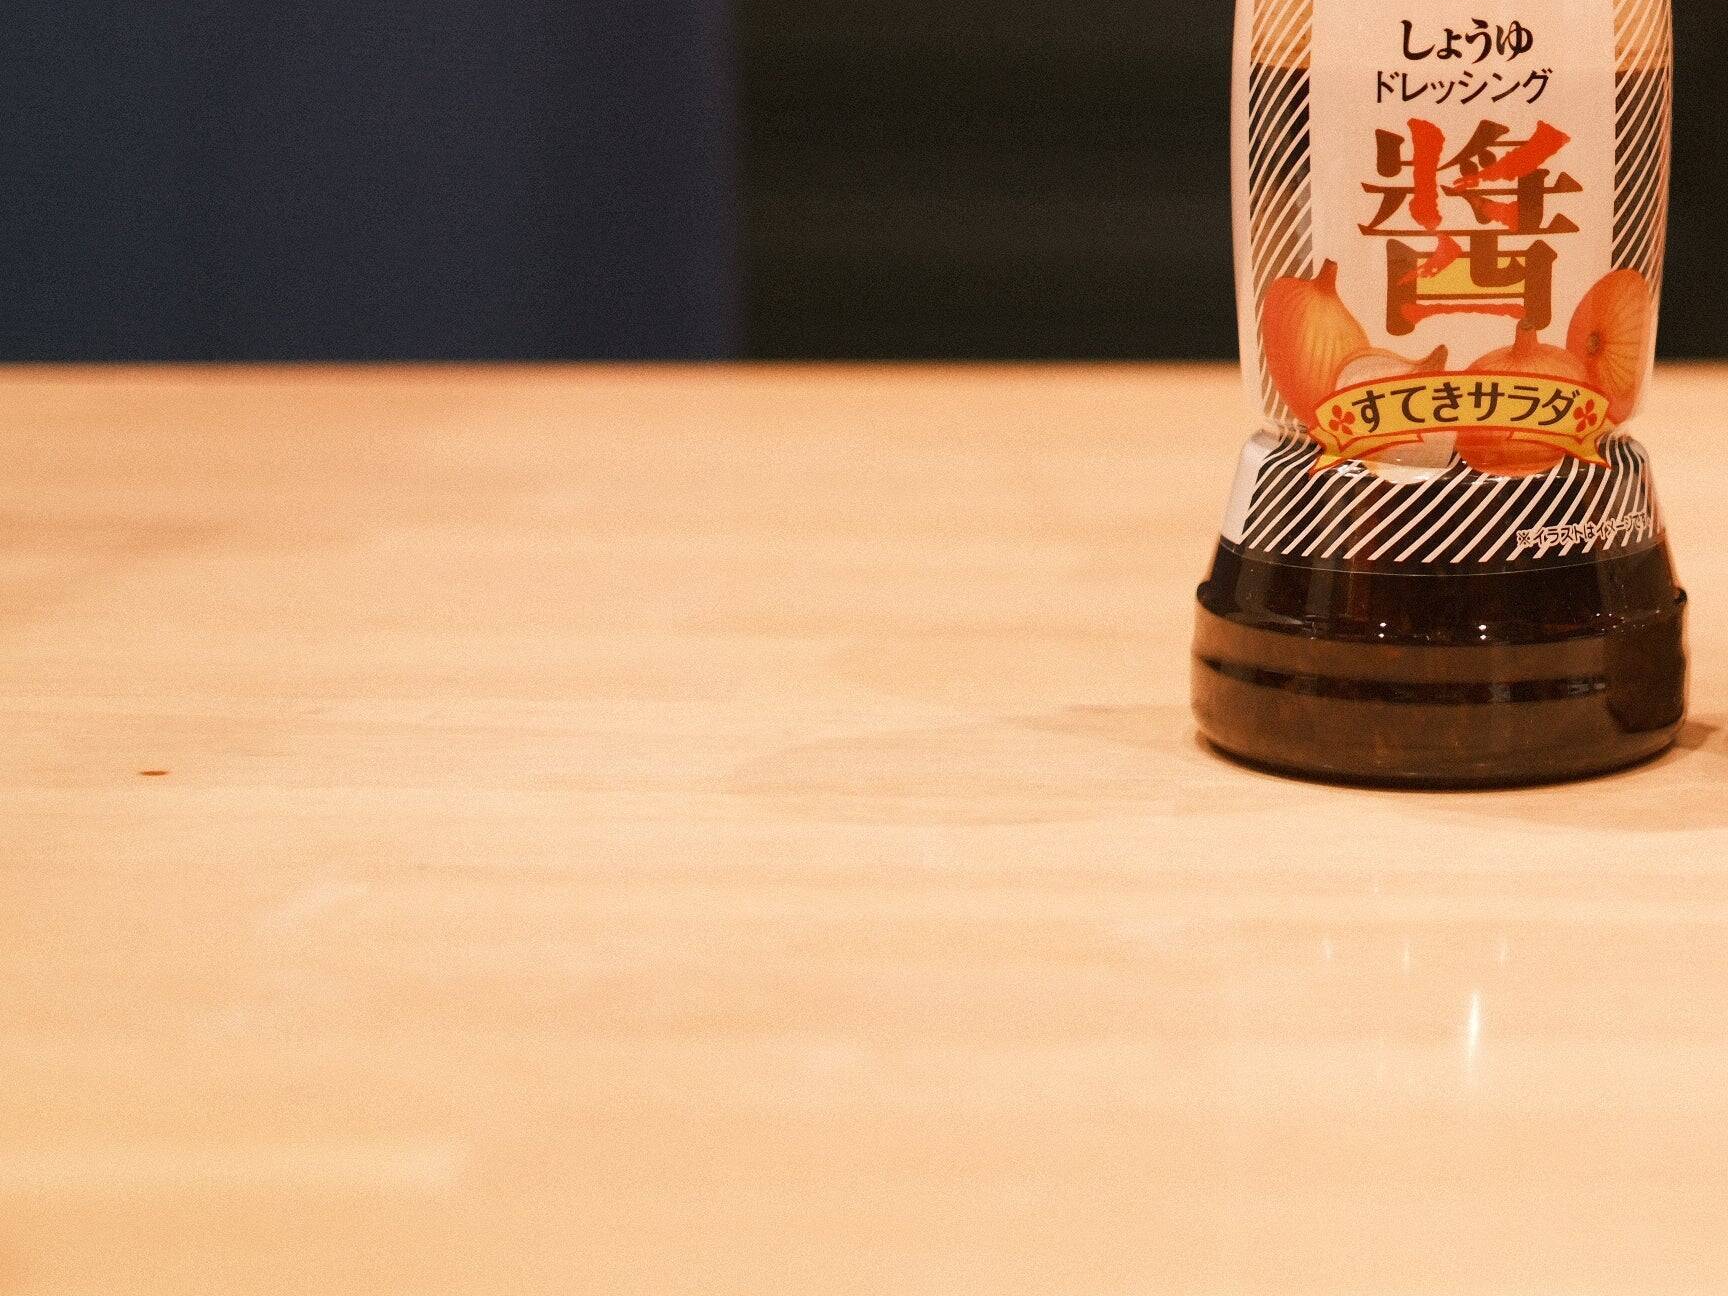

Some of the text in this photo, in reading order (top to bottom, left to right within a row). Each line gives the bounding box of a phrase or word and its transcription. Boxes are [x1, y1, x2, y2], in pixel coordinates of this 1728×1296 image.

[1400, 18, 1534, 64] しょうゆ
[1375, 68, 1553, 104] ドレッシング
[1351, 382, 1581, 433] すてきサラダ
